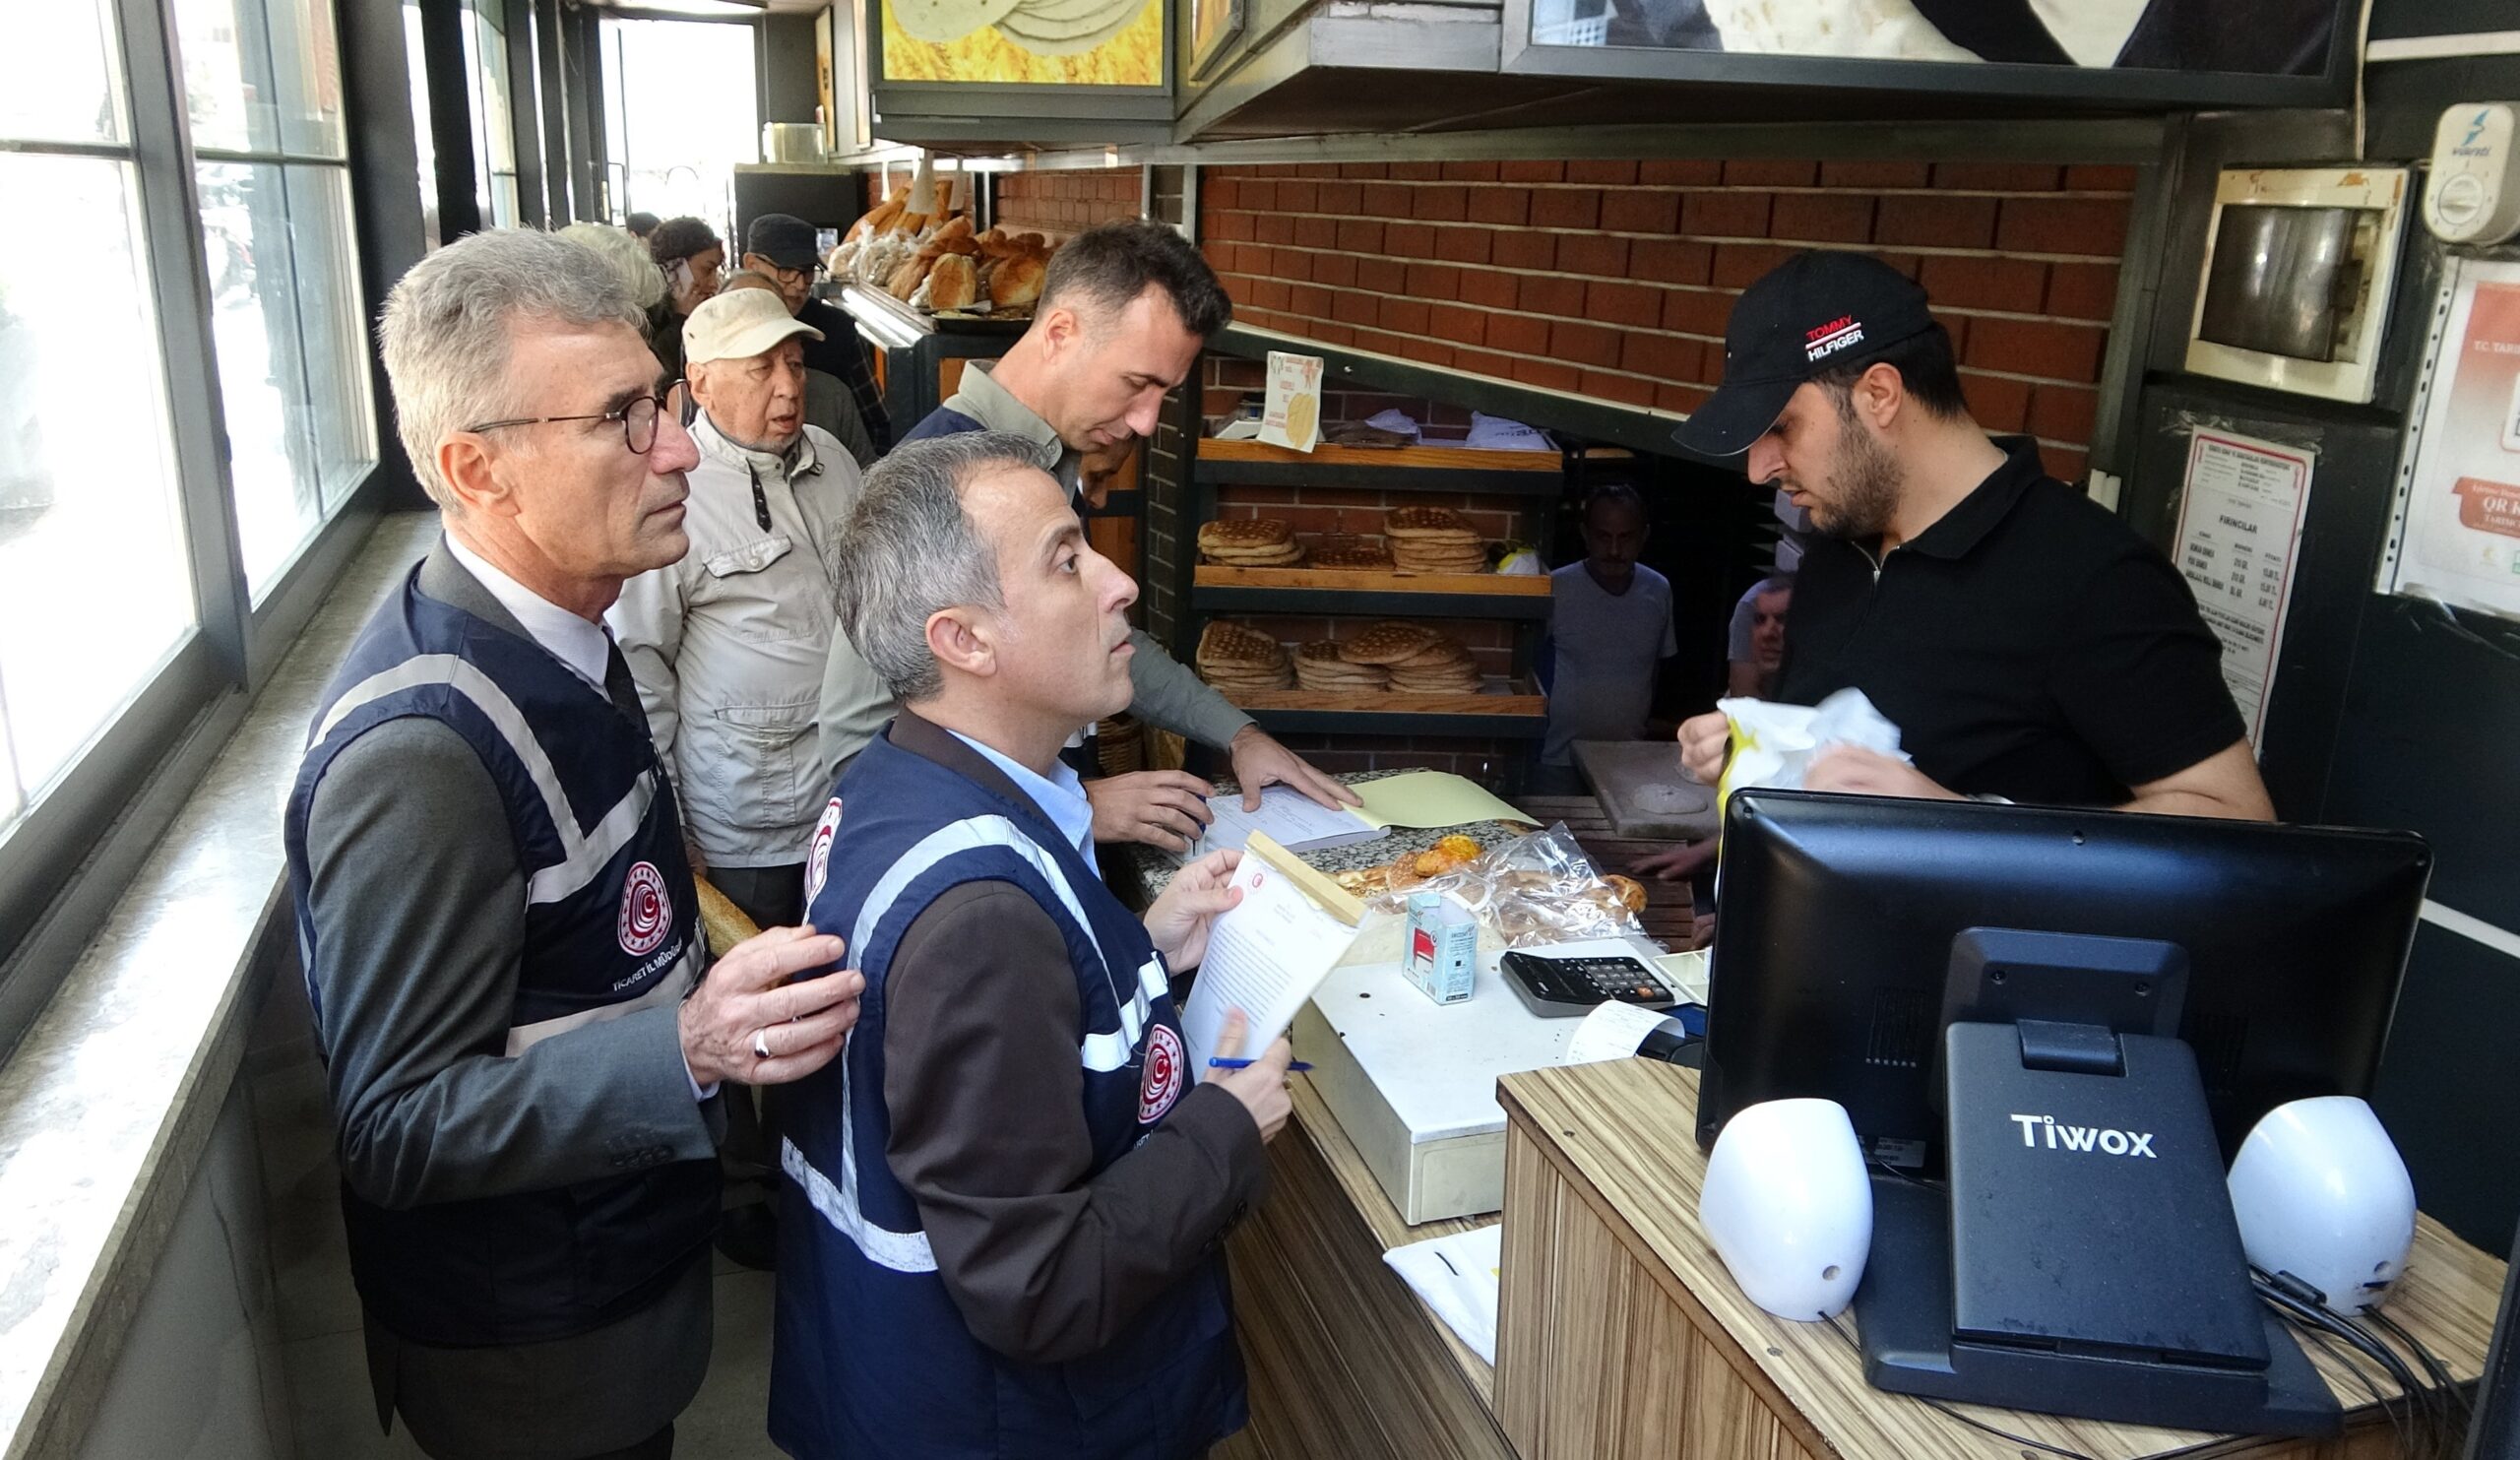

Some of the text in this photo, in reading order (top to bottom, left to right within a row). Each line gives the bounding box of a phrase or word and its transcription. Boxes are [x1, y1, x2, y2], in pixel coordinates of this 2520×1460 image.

[1806, 314, 1853, 341] TOMMY
[1807, 329, 1864, 362] HILFIGER
[2484, 495, 2508, 513] QR
[2219, 514, 2258, 534] FIRINCILAR
[612, 967, 647, 991] TİCARET
[645, 962, 656, 974] İL
[2010, 1113, 2158, 1159] Tiwox
